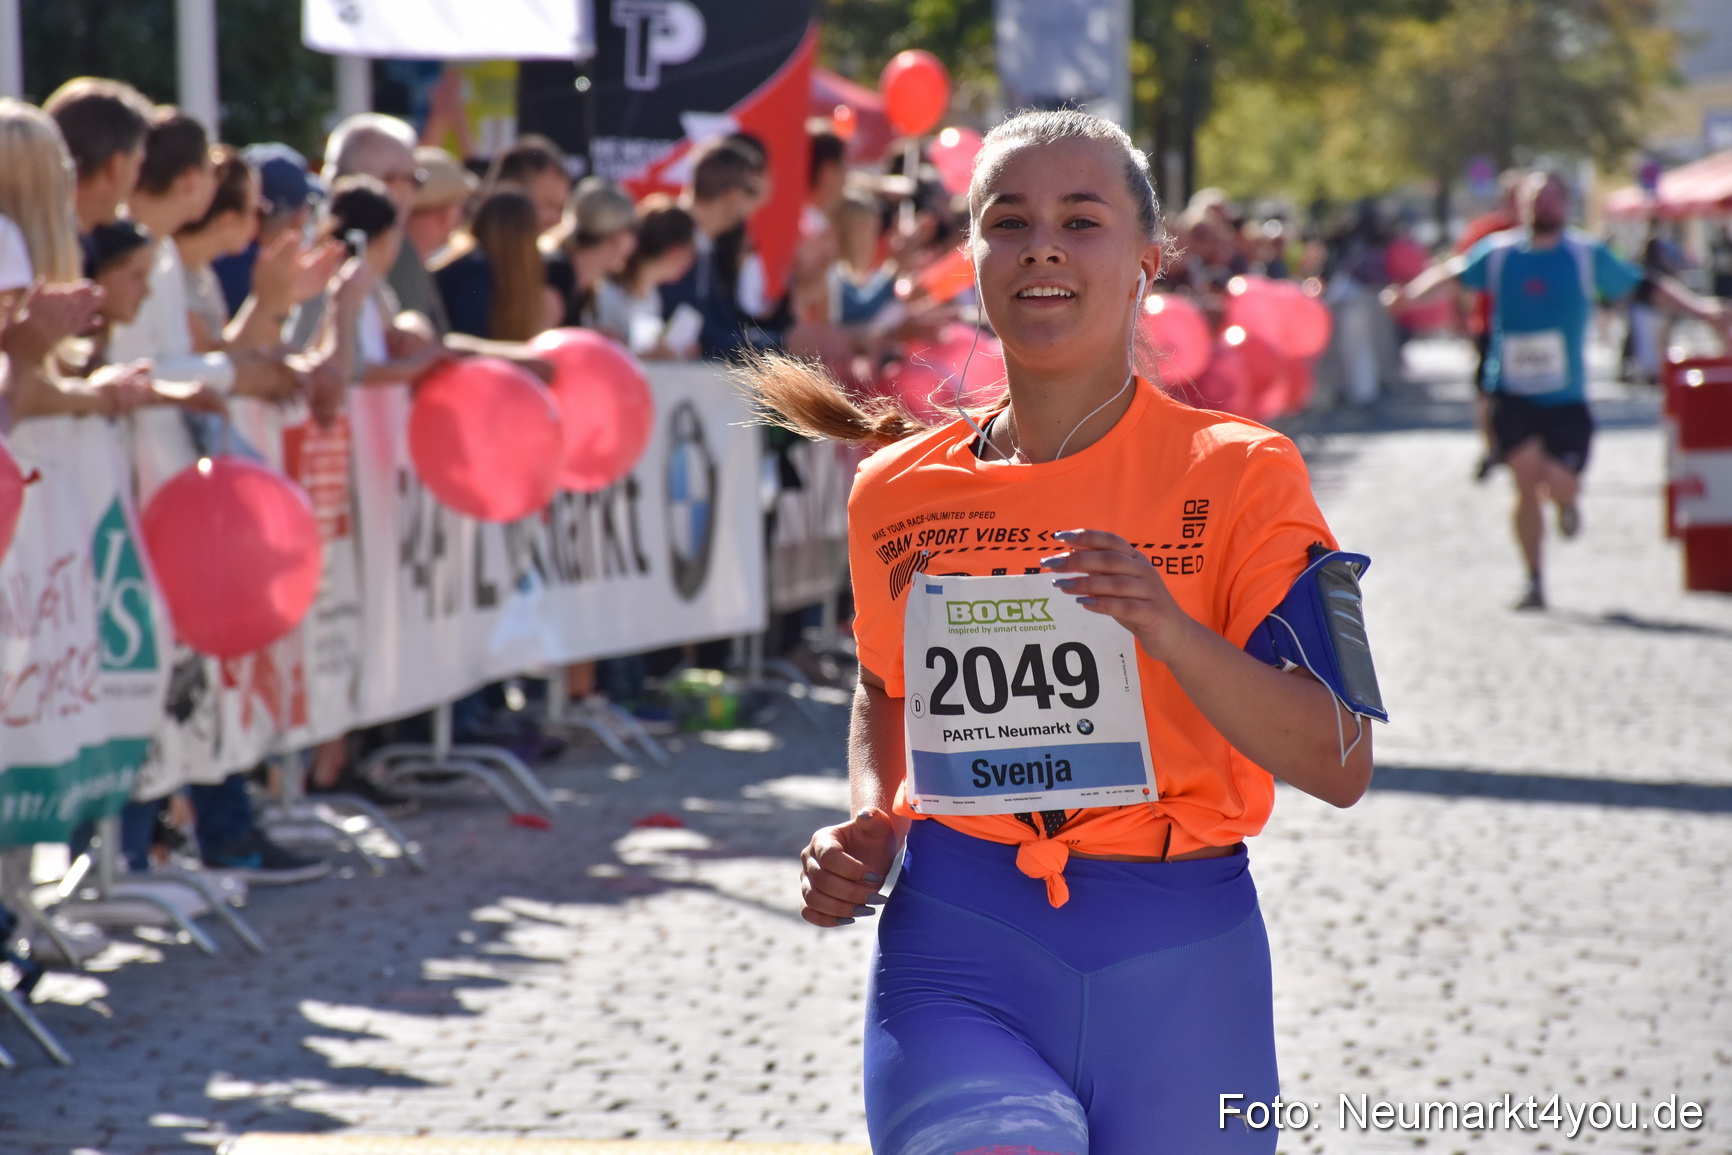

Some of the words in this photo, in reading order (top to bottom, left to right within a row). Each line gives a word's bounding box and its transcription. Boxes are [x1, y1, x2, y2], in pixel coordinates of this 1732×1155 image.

[1183, 499, 1209, 515] 02
[872, 528, 887, 542] MAKE
[886, 521, 905, 535] YOUR
[906, 511, 966, 528] RACE-UNLIMITED
[968, 511, 996, 520] SPEED
[1182, 523, 1206, 539] 67
[875, 532, 913, 565] URBAN
[916, 527, 970, 548] SPORT
[976, 528, 1031, 543] VIBES
[1151, 554, 1204, 575] PEED
[946, 598, 1054, 625] BOCK
[948, 626, 980, 636] inspired
[981, 625, 992, 635] by
[993, 625, 1018, 633] smart
[1019, 623, 1057, 633] concepts
[925, 641, 1100, 716] 2049
[943, 726, 996, 742] PARTL
[998, 722, 1072, 739] Neumarkt
[971, 753, 1073, 790] Svenja
